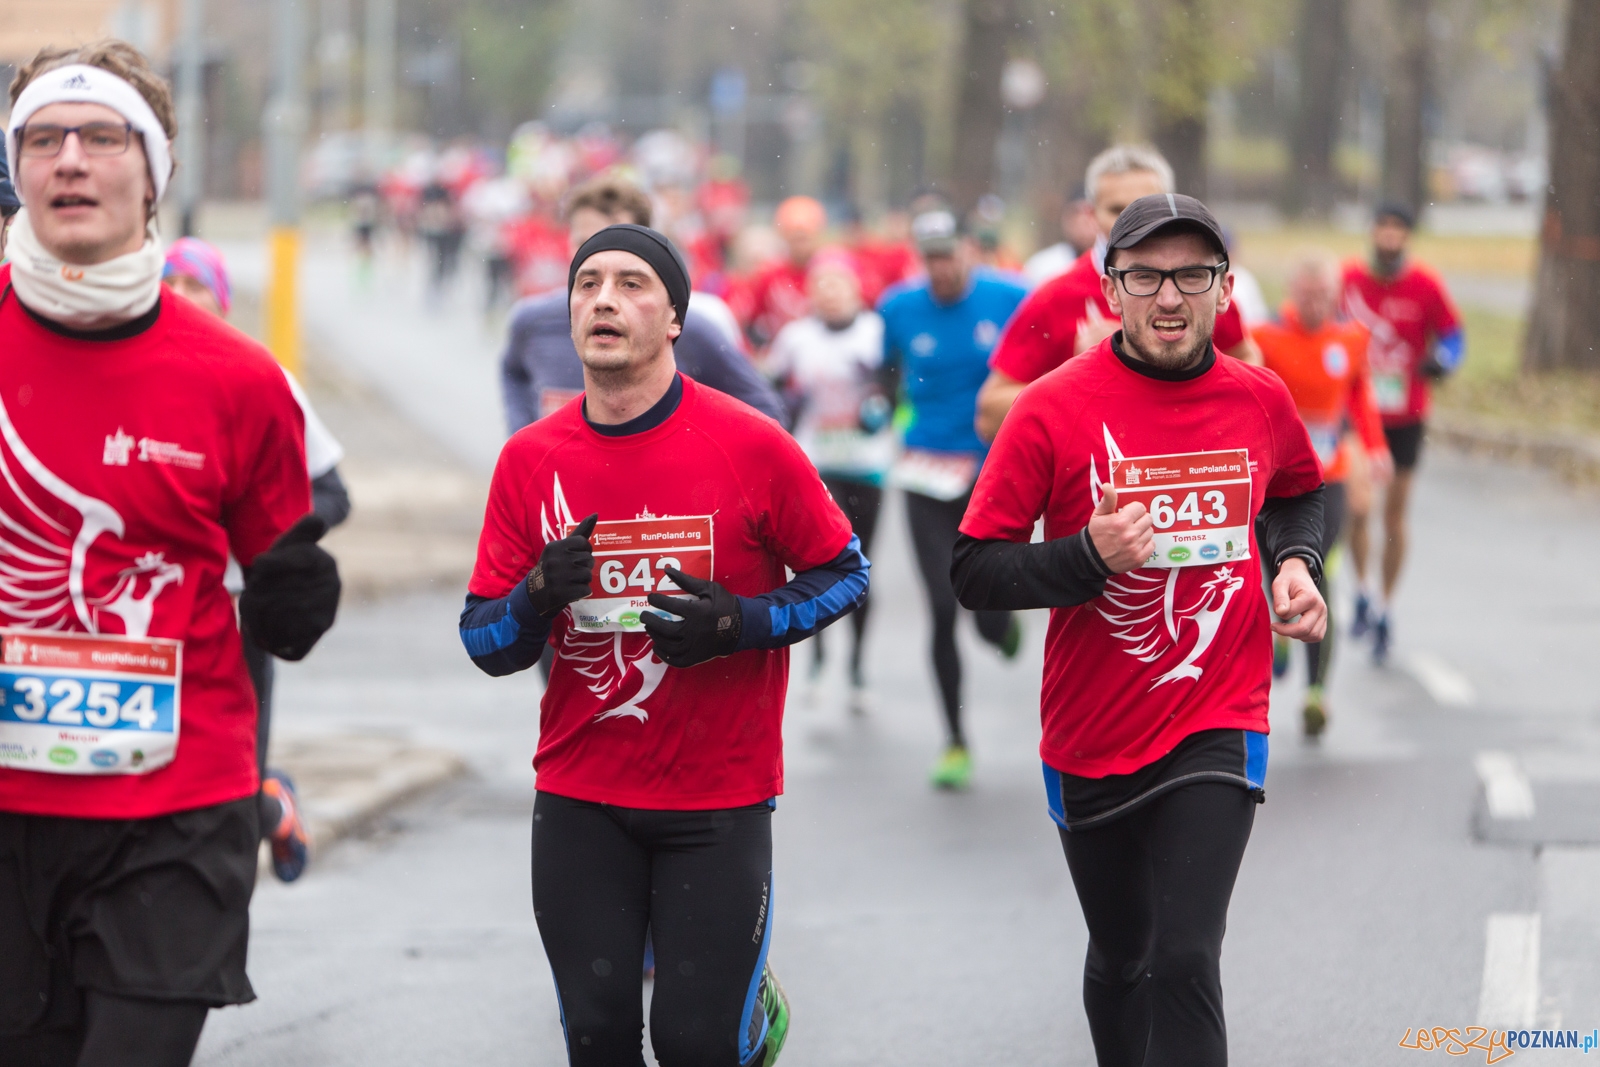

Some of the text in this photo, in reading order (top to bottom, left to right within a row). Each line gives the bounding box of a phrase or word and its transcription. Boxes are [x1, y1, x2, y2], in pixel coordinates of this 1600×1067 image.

[1189, 464, 1241, 475] RunPoland.org
[1150, 490, 1228, 529] 643
[641, 530, 701, 541] RunPoland.org
[1173, 534, 1207, 543] Tomasz
[600, 556, 682, 594] 642
[91, 651, 168, 671] RunPoland.org
[12, 676, 158, 730] 3254
